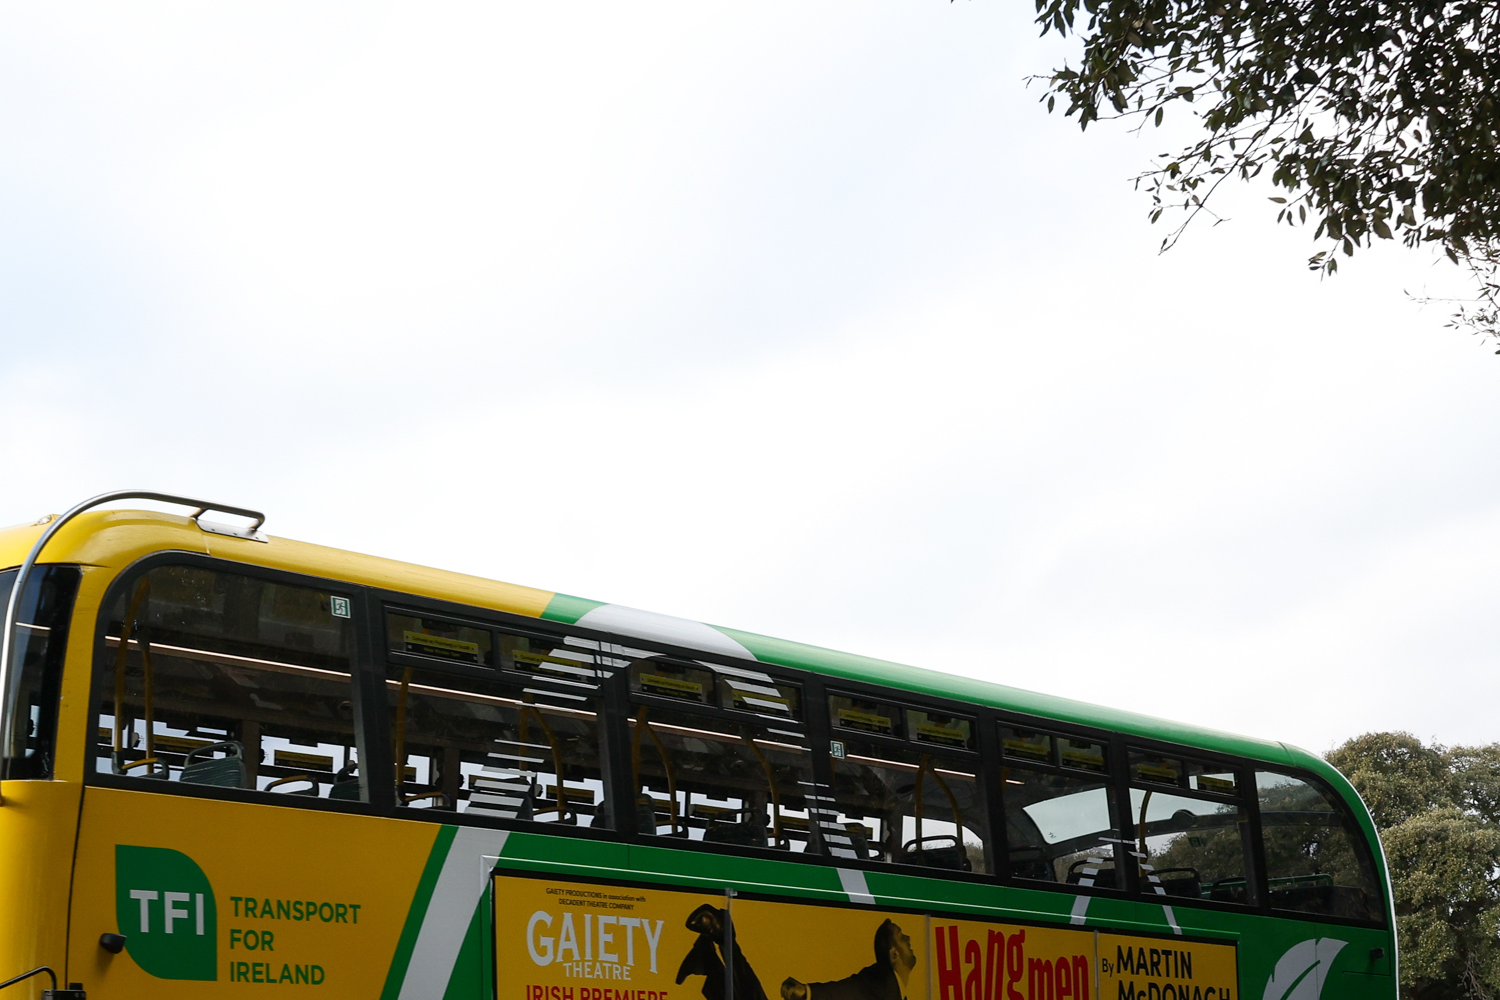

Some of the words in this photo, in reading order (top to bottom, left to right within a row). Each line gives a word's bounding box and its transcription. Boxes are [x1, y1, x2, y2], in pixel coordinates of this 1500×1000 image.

[546, 888, 565, 896] GAIETY
[566, 889, 602, 899] PRODUCTIONS
[559, 898, 586, 906] DECADENT
[129, 889, 205, 936] TFI
[229, 896, 362, 925] TRANSPORT
[229, 928, 275, 952] FOR
[525, 909, 665, 975] GAIETY
[229, 961, 326, 986] IRELAND
[562, 961, 633, 981] THEATRE
[1101, 957, 1115, 978] By
[1116, 944, 1193, 980] MARTIN
